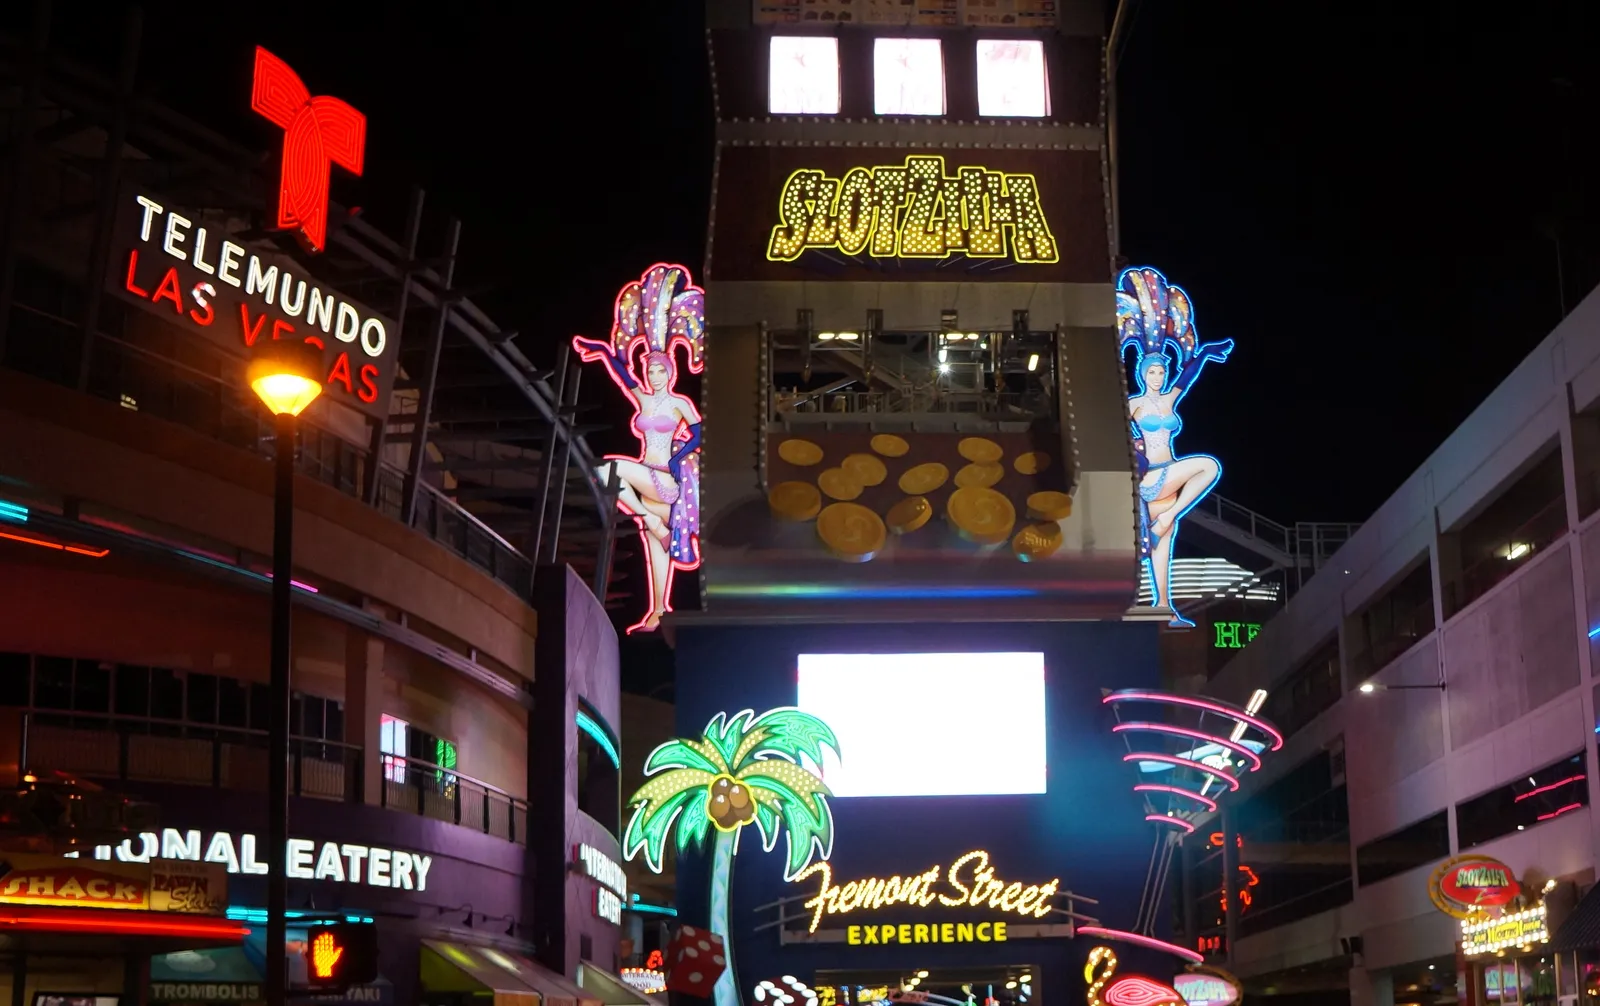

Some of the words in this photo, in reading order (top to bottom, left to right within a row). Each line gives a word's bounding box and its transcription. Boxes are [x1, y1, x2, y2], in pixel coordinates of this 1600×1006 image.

[766, 155, 1060, 264] SLOTZILLA
[136, 195, 387, 357] TELEMUNDO
[126, 249, 217, 326] LAS
[240, 303, 380, 404] VAS
[3, 875, 138, 901] SHACK
[64, 828, 269, 874] ONAL
[285, 838, 432, 892] EATERY
[795, 861, 941, 934] Fremont
[938, 850, 1060, 918] Street
[847, 921, 1008, 945] EXPERIENCE
[152, 984, 260, 999] TROMBOLIS
